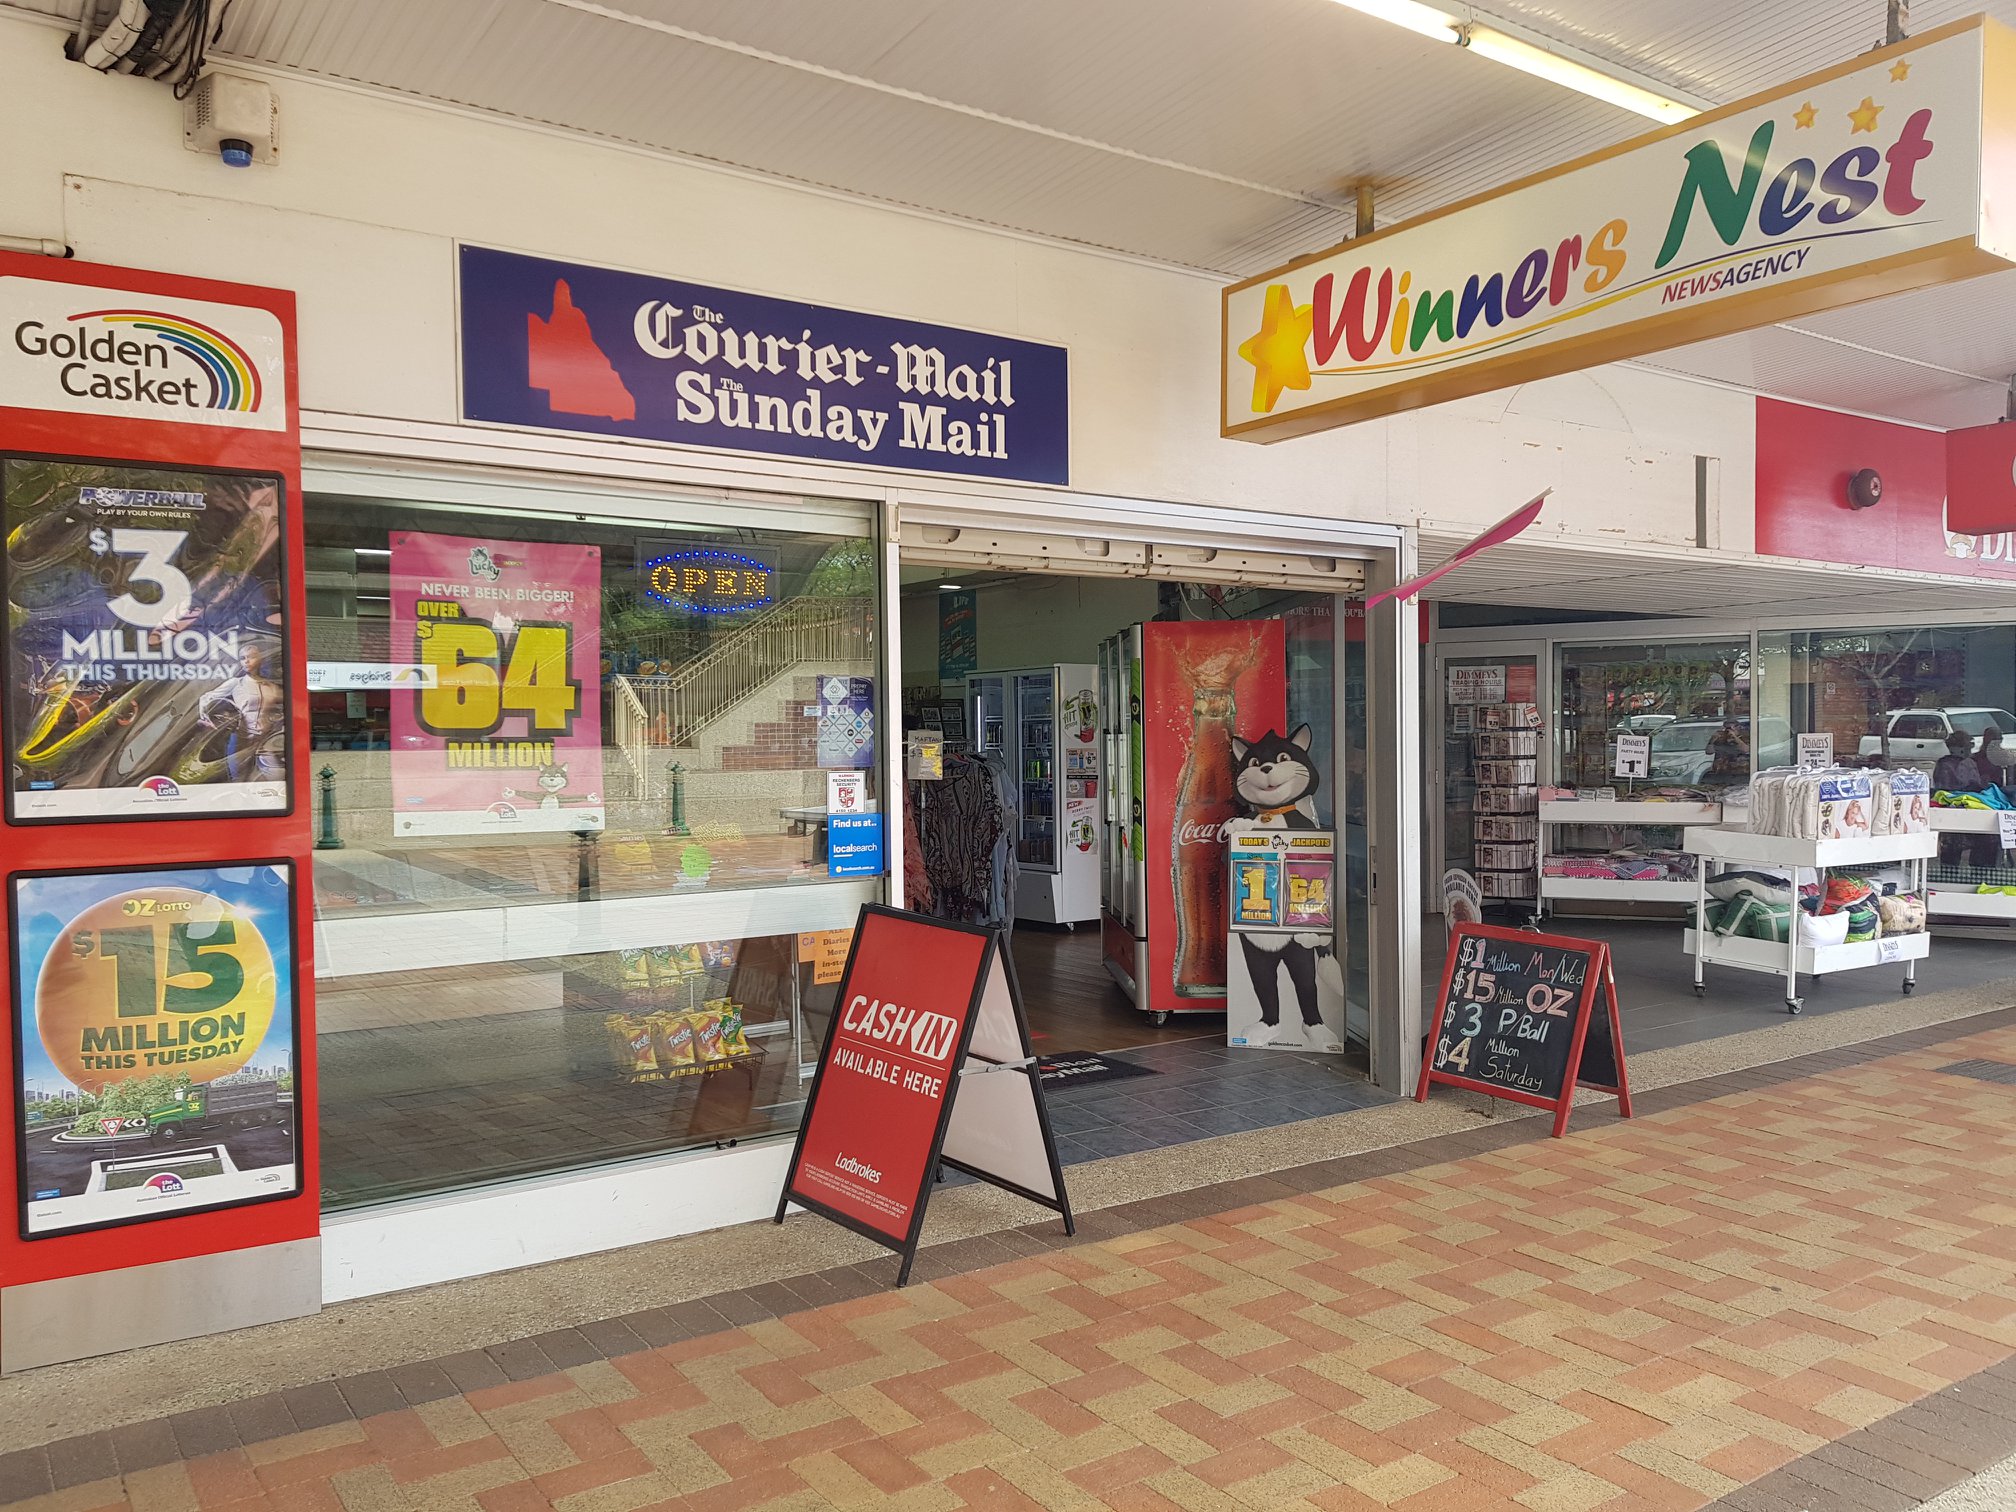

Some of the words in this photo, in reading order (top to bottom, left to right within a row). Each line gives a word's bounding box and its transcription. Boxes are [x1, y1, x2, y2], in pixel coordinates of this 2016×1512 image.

[1312, 217, 1628, 367] Winners
[1654, 108, 1933, 270] Nest
[1660, 246, 1813, 305] NEWSAGENCY
[693, 304, 724, 325] The
[15, 321, 168, 369] Golden
[634, 300, 1015, 407] Courier-Mail
[60, 362, 199, 408] Casket
[721, 377, 744, 393] The
[675, 371, 888, 452] Sunday
[899, 401, 1009, 461] Mail
[79, 487, 207, 510] POWERBALL
[97, 508, 115, 516] PLAY
[421, 583, 470, 598] NEVER
[475, 586, 511, 600] BEEN
[516, 588, 574, 603] BIGGER!
[652, 566, 768, 596] OPEN
[417, 601, 461, 618] OVER
[62, 629, 239, 661] MILLION
[63, 664, 116, 681] THIS
[122, 664, 239, 681] THURSDAY
[417, 621, 575, 729] $64
[447, 742, 552, 767] MILLION
[833, 819, 851, 828] Find
[853, 820, 862, 828] us
[833, 842, 878, 854] localsearch
[1239, 837, 1269, 846] TODAY'S
[1290, 837, 1331, 847] JACKPOTS
[122, 898, 157, 916] OZ
[157, 901, 192, 913] LOTTO
[1241, 911, 1272, 920] MILLION
[822, 937, 850, 946] Diaries
[71, 921, 245, 1018] $15
[817, 970, 842, 980] please
[822, 960, 846, 968] in-sto
[1459, 937, 1487, 969] $1
[1487, 950, 1521, 973] Million
[1524, 951, 1587, 986] Mon/Wed
[1452, 968, 1496, 1003] $15
[1495, 985, 1524, 1006] Million
[1526, 983, 1574, 1019] OZ
[81, 1012, 246, 1053] MILLION
[843, 994, 916, 1046] CASH
[914, 1014, 953, 1058] IN
[1498, 1008, 1550, 1043] P/Ball
[82, 1051, 136, 1069] THIS
[145, 1038, 245, 1067] TUESDAY
[1435, 1033, 1472, 1072] $4
[1485, 1037, 1520, 1058] Million
[833, 1047, 901, 1085] AVAILABLE
[902, 1068, 943, 1099] HERE
[1479, 1056, 1543, 1089] Saturday
[835, 1151, 883, 1184] Ladbrokes
[162, 1183, 182, 1192] Lott
